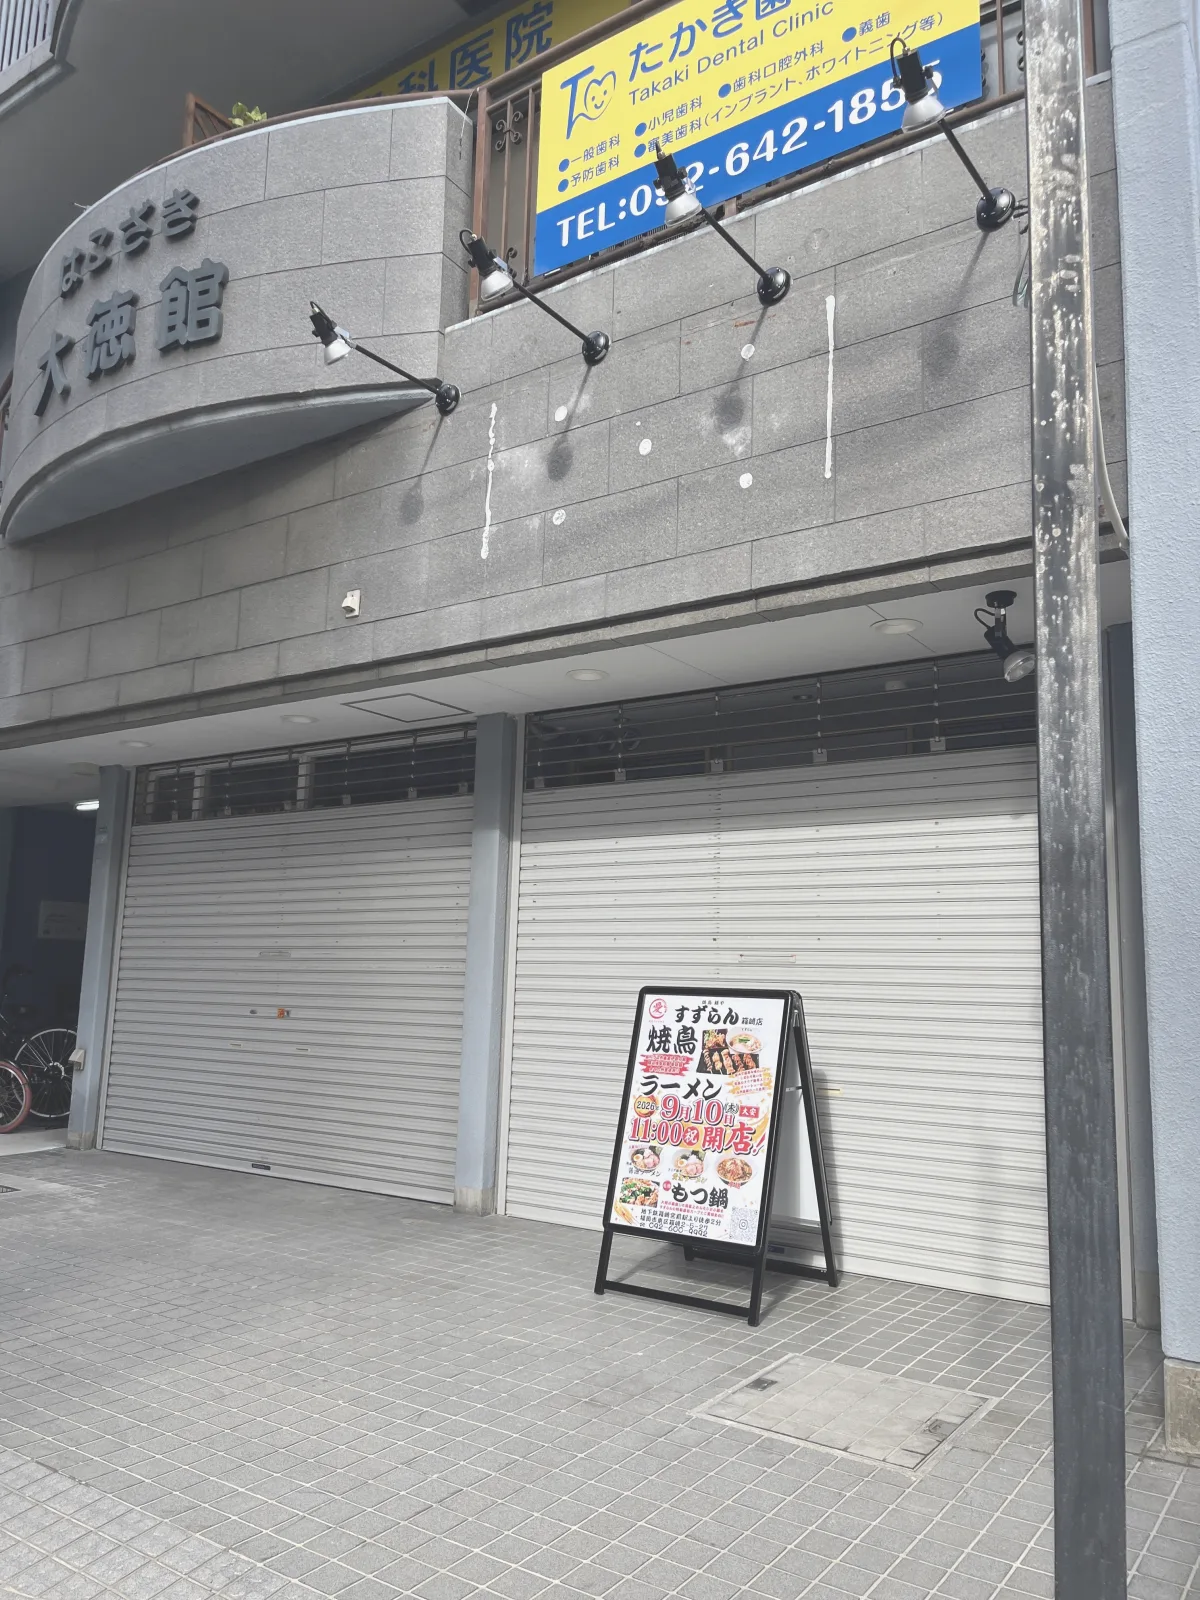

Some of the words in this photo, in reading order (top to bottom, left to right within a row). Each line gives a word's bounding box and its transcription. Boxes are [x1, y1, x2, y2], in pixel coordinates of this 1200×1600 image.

[366, 2, 554, 97] 科医院
[629, 65, 690, 106] Takaki
[697, 30, 765, 75] Dental
[773, 1, 834, 38] Clinic
[571, 133, 621, 163] 一般歯科
[648, 96, 703, 131] 小児歯科
[733, 40, 825, 92] 歯科口腔外科
[858, 11, 891, 36] 義歯
[570, 154, 620, 188] 予防歯科
[60, 188, 201, 298] はこざき
[34, 257, 230, 417] 大徳館
[675, 1005, 740, 1026] すずらん
[646, 1024, 698, 1055] 焼鳥
[640, 1074, 722, 1101] ラーメン
[629, 1117, 684, 1145] 11:00
[671, 1182, 729, 1210] もつ鍋
